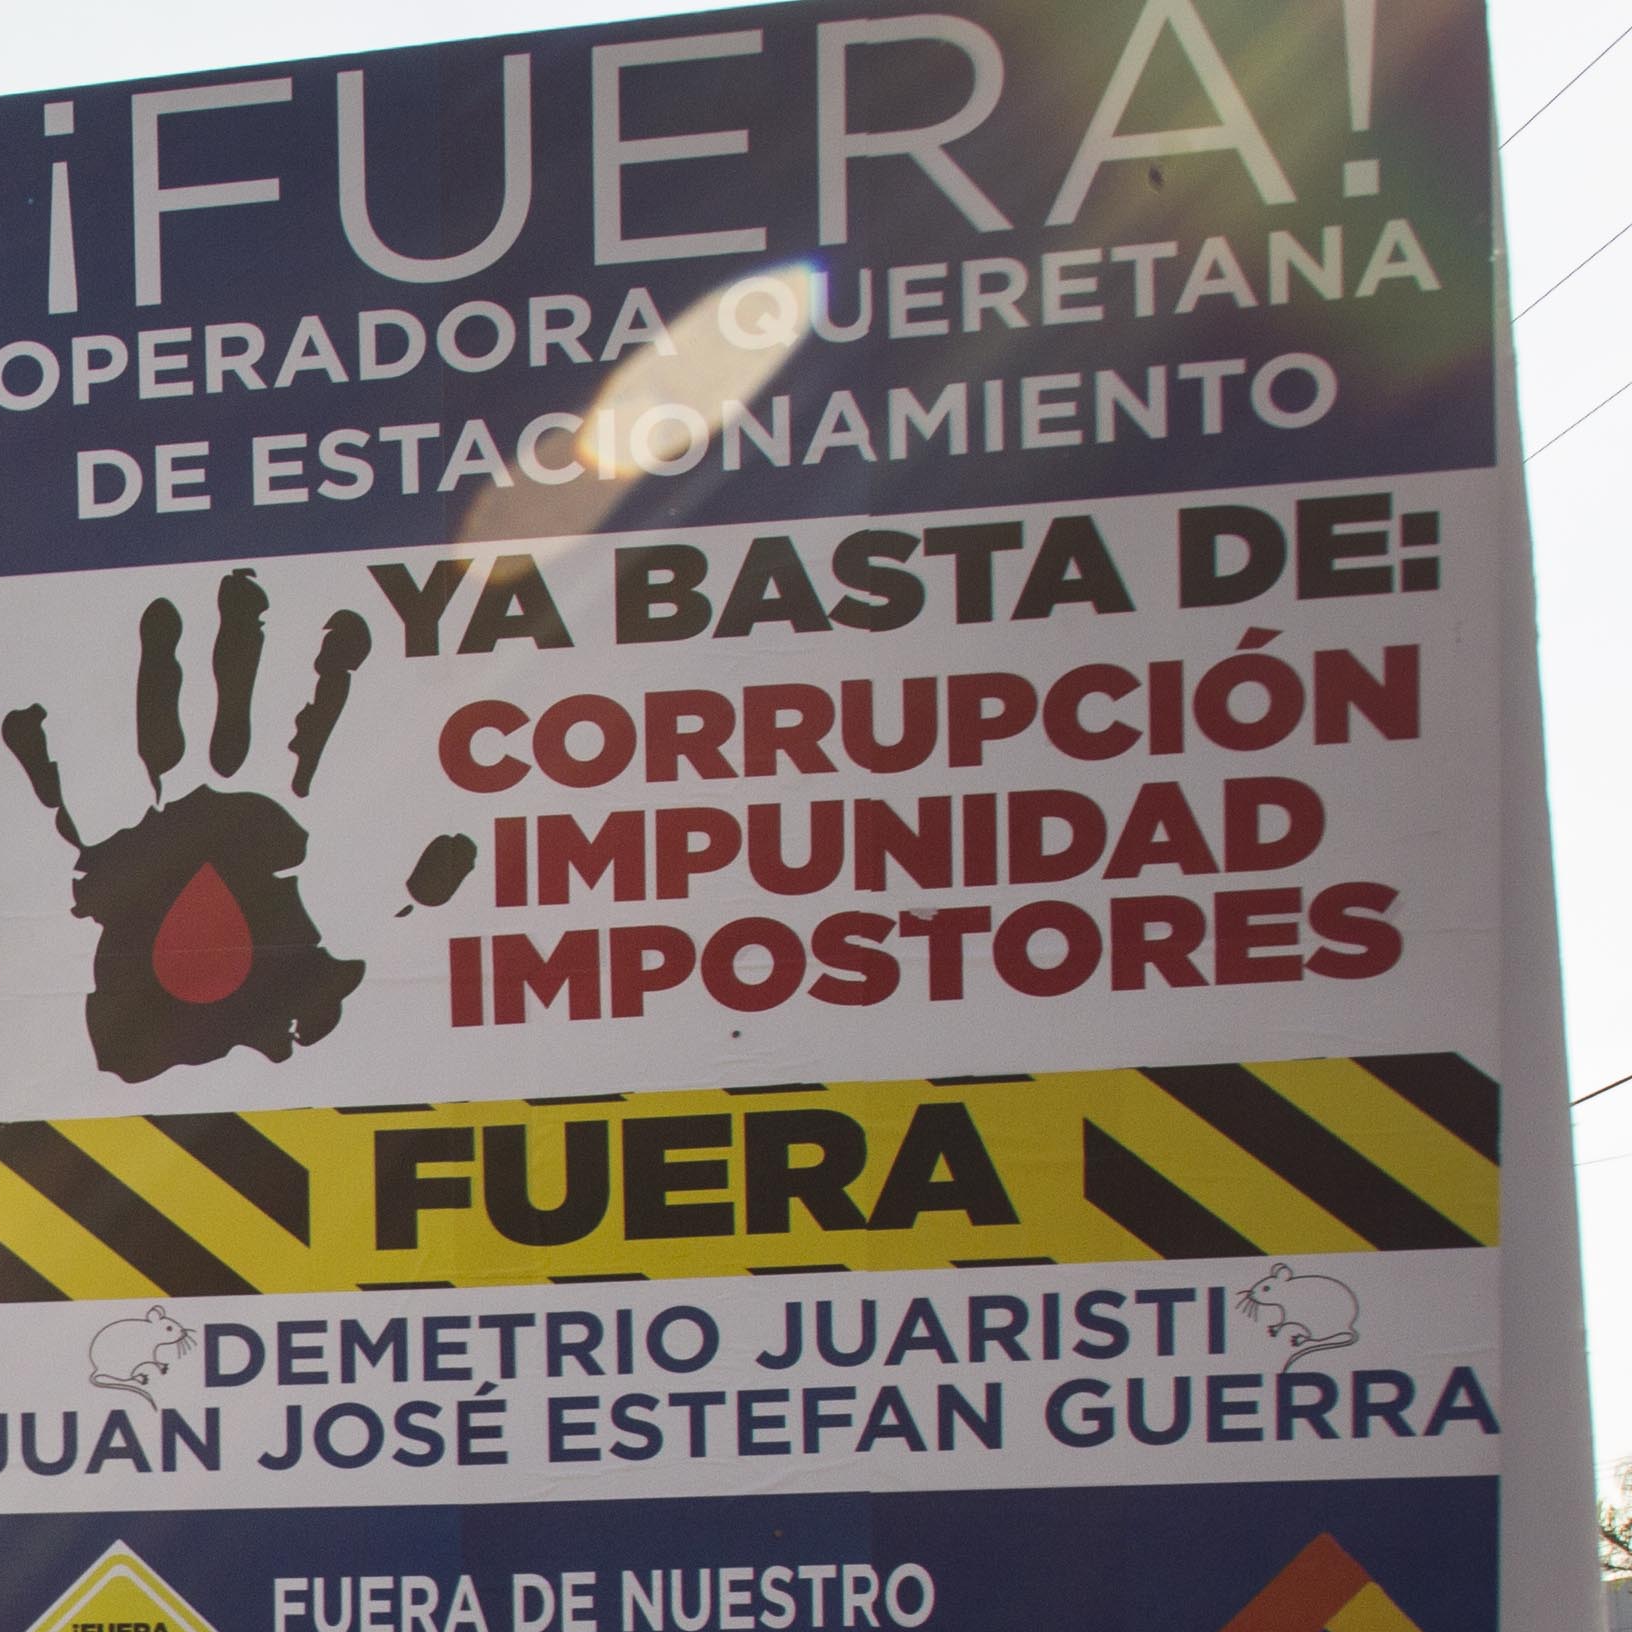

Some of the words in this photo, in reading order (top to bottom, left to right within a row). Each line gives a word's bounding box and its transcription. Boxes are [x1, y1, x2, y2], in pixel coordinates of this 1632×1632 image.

[44, 0, 1379, 314] ¡FUERA!
[716, 220, 1439, 352] QUERETANA
[77, 442, 210, 519] DE
[253, 354, 1336, 505] ESTACIONAMIENTO
[367, 558, 574, 658] YA
[615, 515, 1136, 644] BASTA
[1179, 493, 1440, 608] DE:
[439, 626, 1421, 793] CORRUPCIÓN
[495, 776, 1326, 907] IMPUNIDAD
[450, 881, 1404, 1027] IMPOSTORES
[372, 1101, 1018, 1250] FUERA
[205, 1306, 719, 1387] DEMETRIO
[756, 1287, 1225, 1369] JUARISTI
[258, 1381, 508, 1470] JOSÉ
[548, 1382, 1002, 1462] ESTEFAN
[1046, 1365, 1500, 1447] GUERRA
[622, 1563, 934, 1632] NUESTRO
